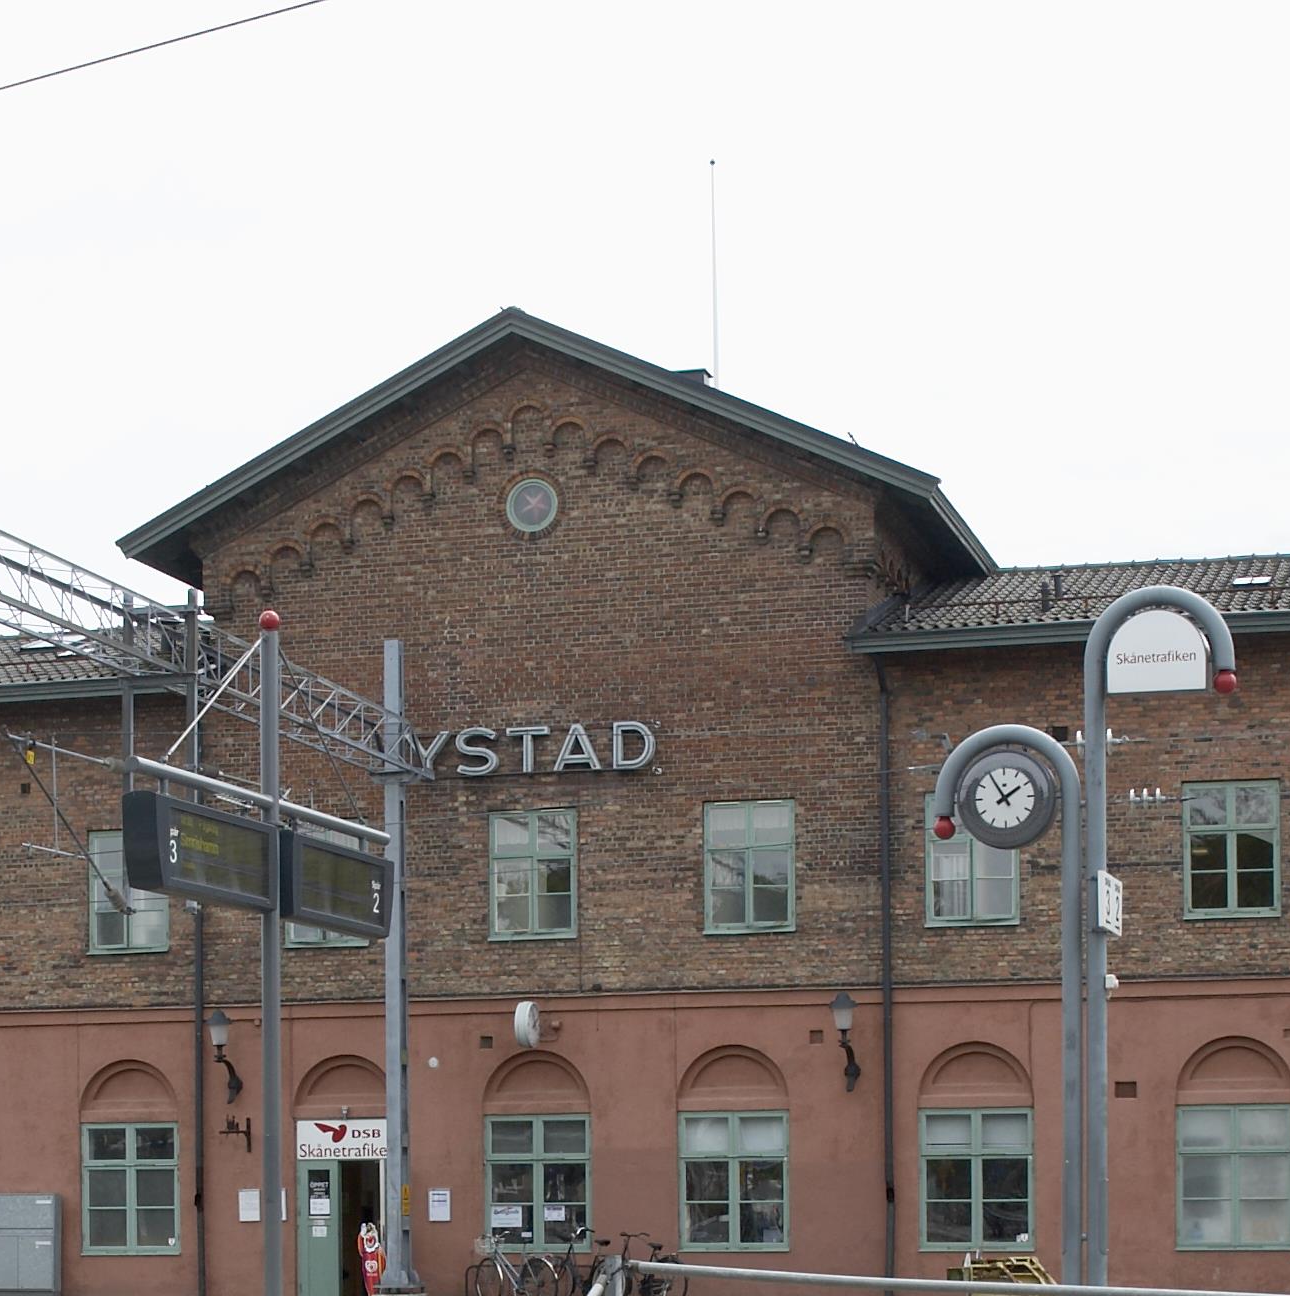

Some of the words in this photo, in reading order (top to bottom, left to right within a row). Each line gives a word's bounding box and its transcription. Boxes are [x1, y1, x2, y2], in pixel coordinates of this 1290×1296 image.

[1116, 650, 1197, 665] Skånetrafiken
[406, 720, 657, 777] YSTAD
[169, 839, 178, 864] 3
[372, 892, 380, 914] 2
[1105, 889, 1111, 916] 3
[1115, 895, 1121, 922] 2
[351, 1128, 381, 1139] DSB
[299, 1142, 388, 1158] Skånetrafike
